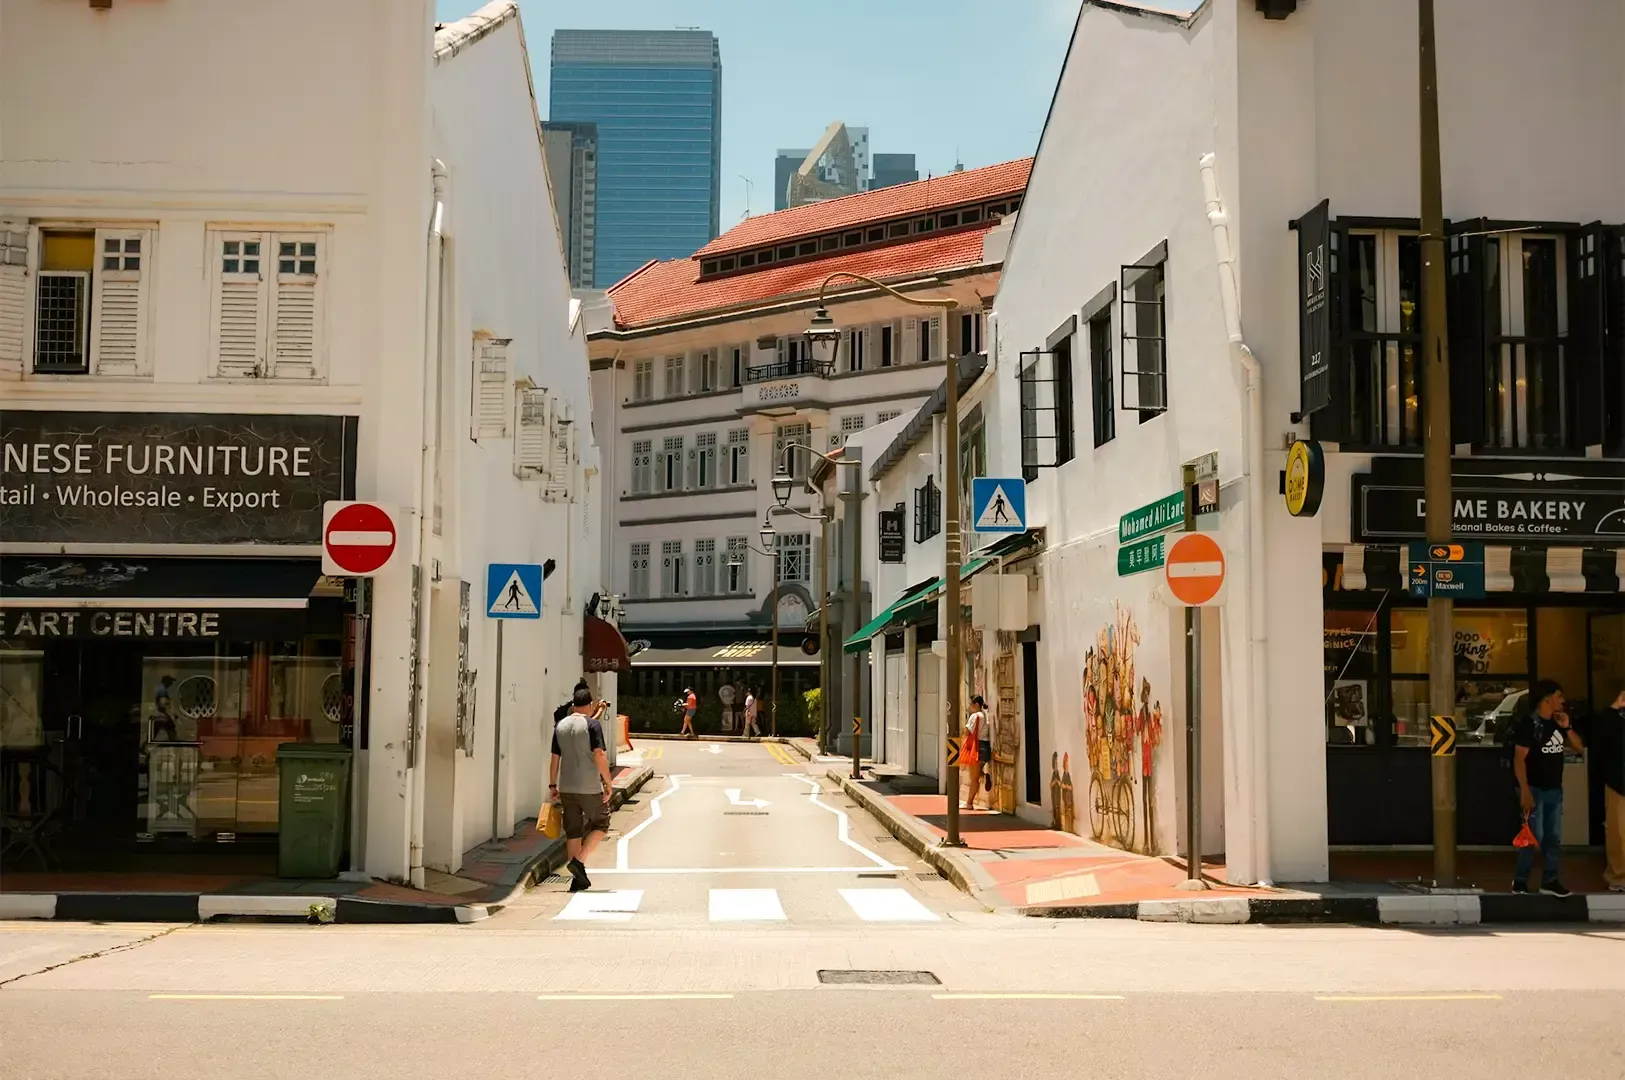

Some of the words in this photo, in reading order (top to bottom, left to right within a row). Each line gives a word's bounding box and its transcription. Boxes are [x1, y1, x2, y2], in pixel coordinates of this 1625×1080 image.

[3, 443, 93, 474] NESE
[105, 444, 311, 477] FURNITURE
[0, 484, 36, 506] tail
[56, 485, 181, 508] Wholesale
[202, 487, 281, 513] Export
[1416, 499, 1488, 519] DME
[1496, 500, 1587, 521] BAKERY
[1121, 515, 1153, 538] Mohamed
[1154, 505, 1166, 526] Ali
[1166, 500, 1185, 520] Lane
[1451, 523, 1483, 532] isanal
[1485, 523, 1516, 533] Bakes
[1517, 524, 1526, 533] &
[1527, 524, 1562, 533] Coffee
[1435, 582, 1464, 590] Maxwell
[14, 612, 81, 636] ART
[90, 612, 220, 637] CENTRE
[1541, 744, 1564, 754] adid
